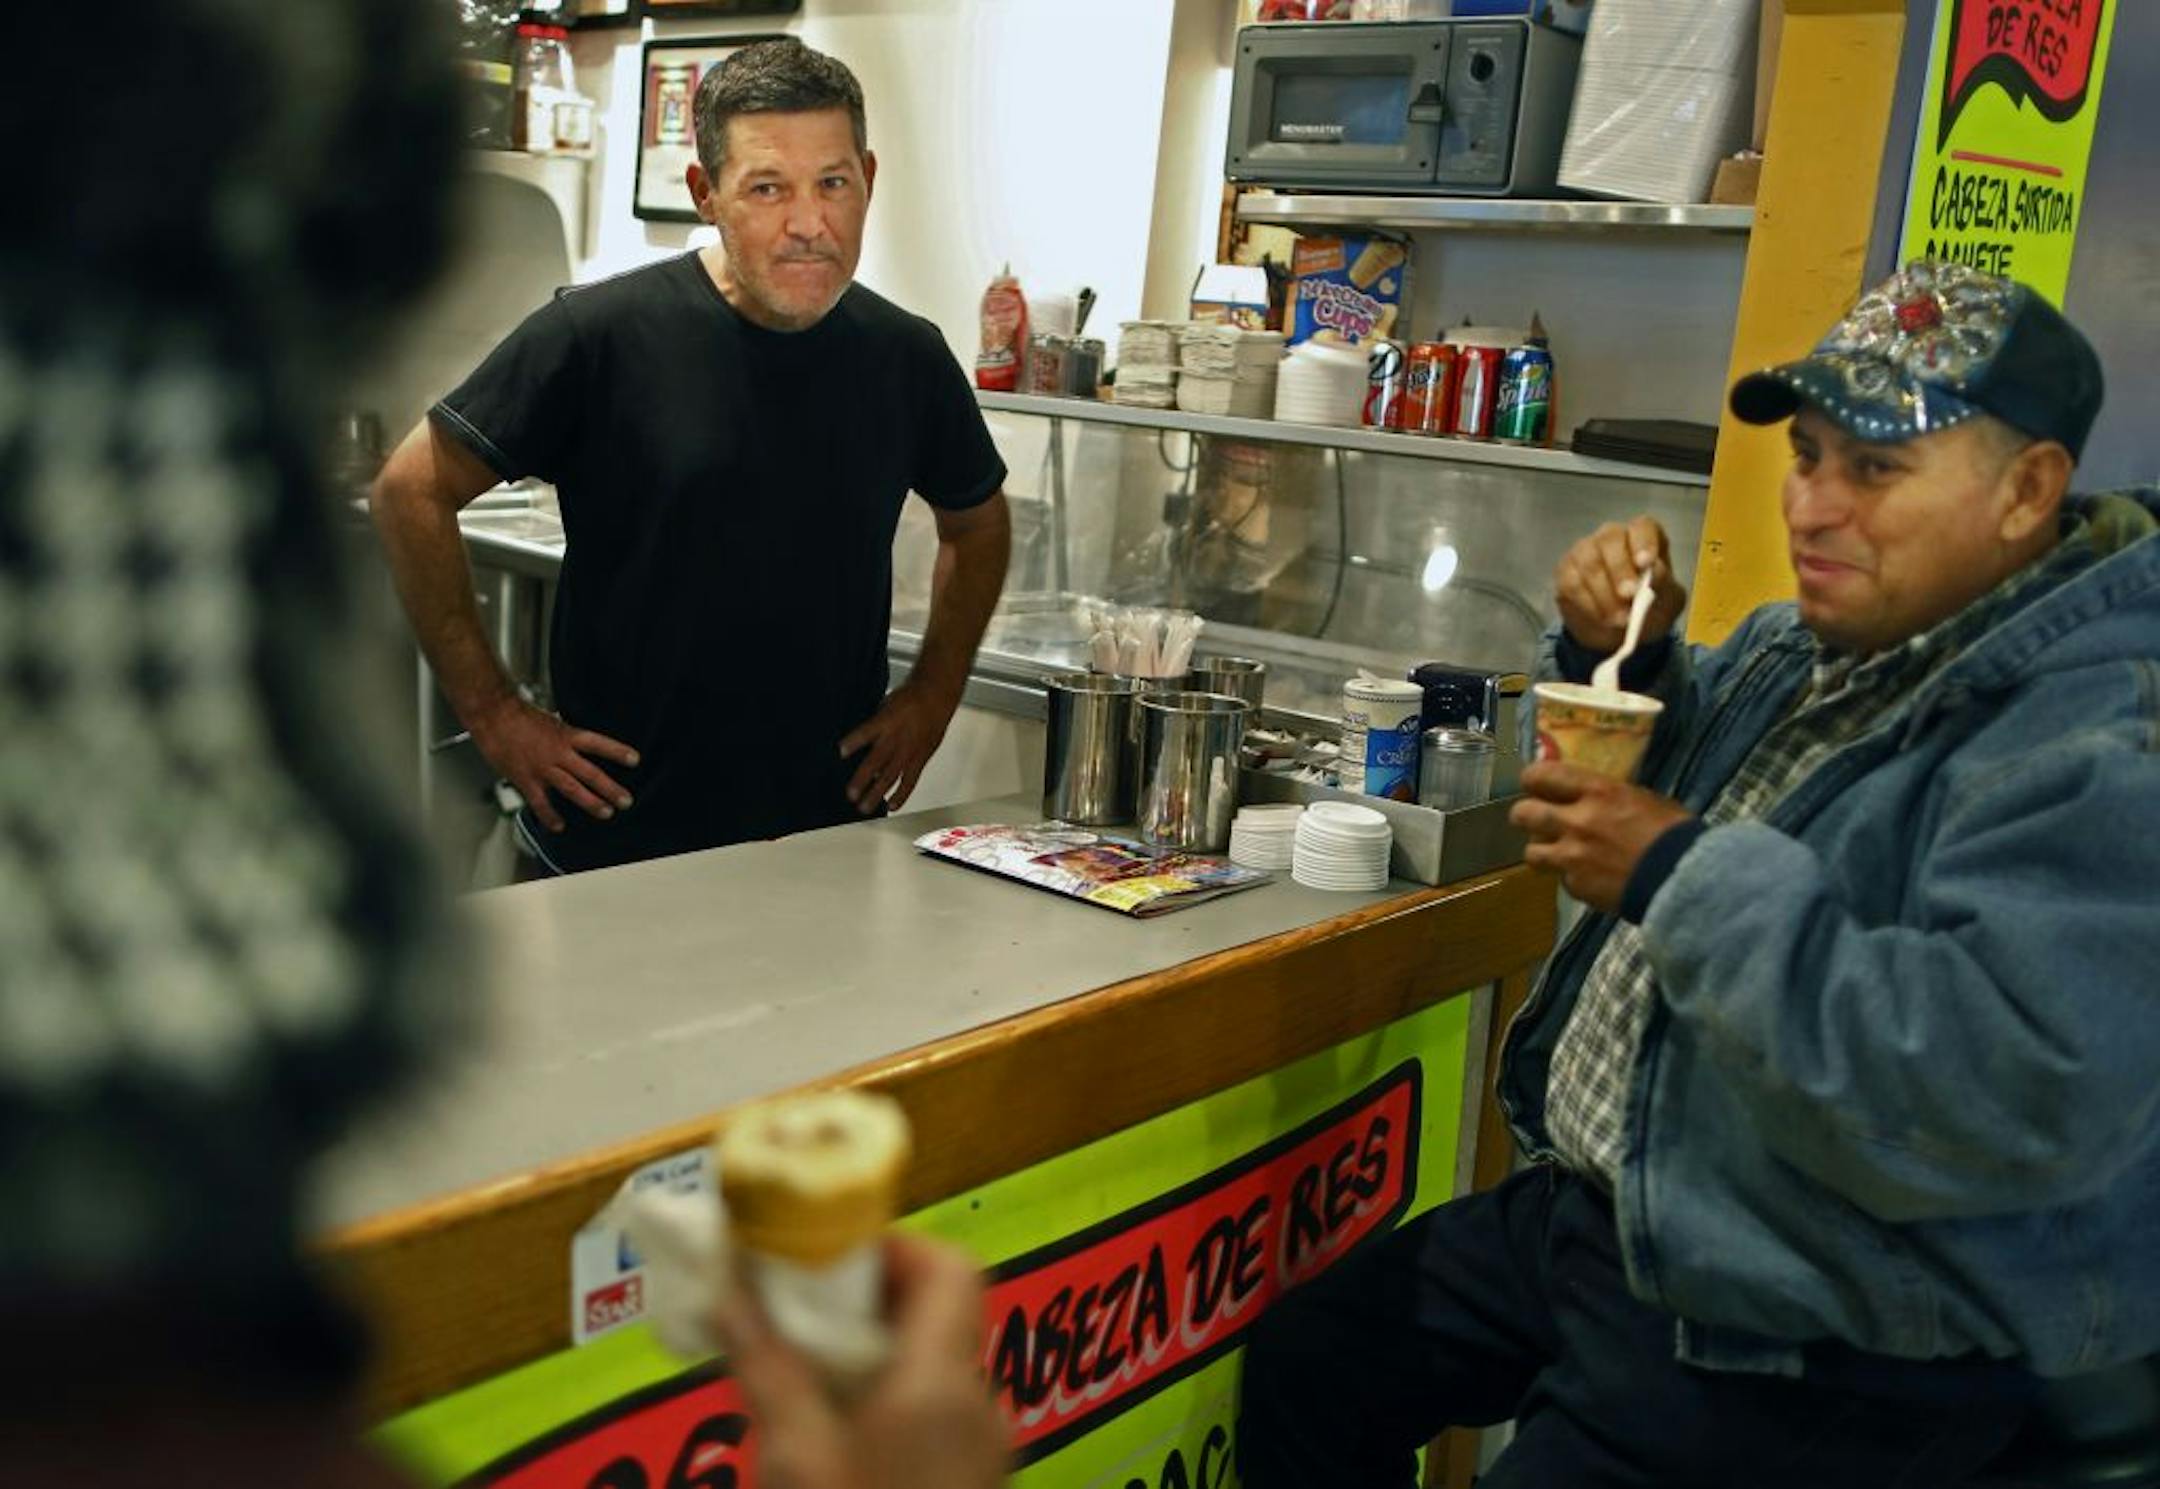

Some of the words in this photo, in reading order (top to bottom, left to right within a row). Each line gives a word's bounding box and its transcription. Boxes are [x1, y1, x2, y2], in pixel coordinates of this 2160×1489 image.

[1987, 6, 2021, 47] DE
[2023, 12, 2069, 77] RES
[1931, 166, 2008, 231] CABEZA
[1314, 298, 1374, 340] Cups
[984, 1243, 1169, 1416] ABEZA
[1186, 1196, 1272, 1326] DE
[1286, 1115, 1390, 1272] RES
